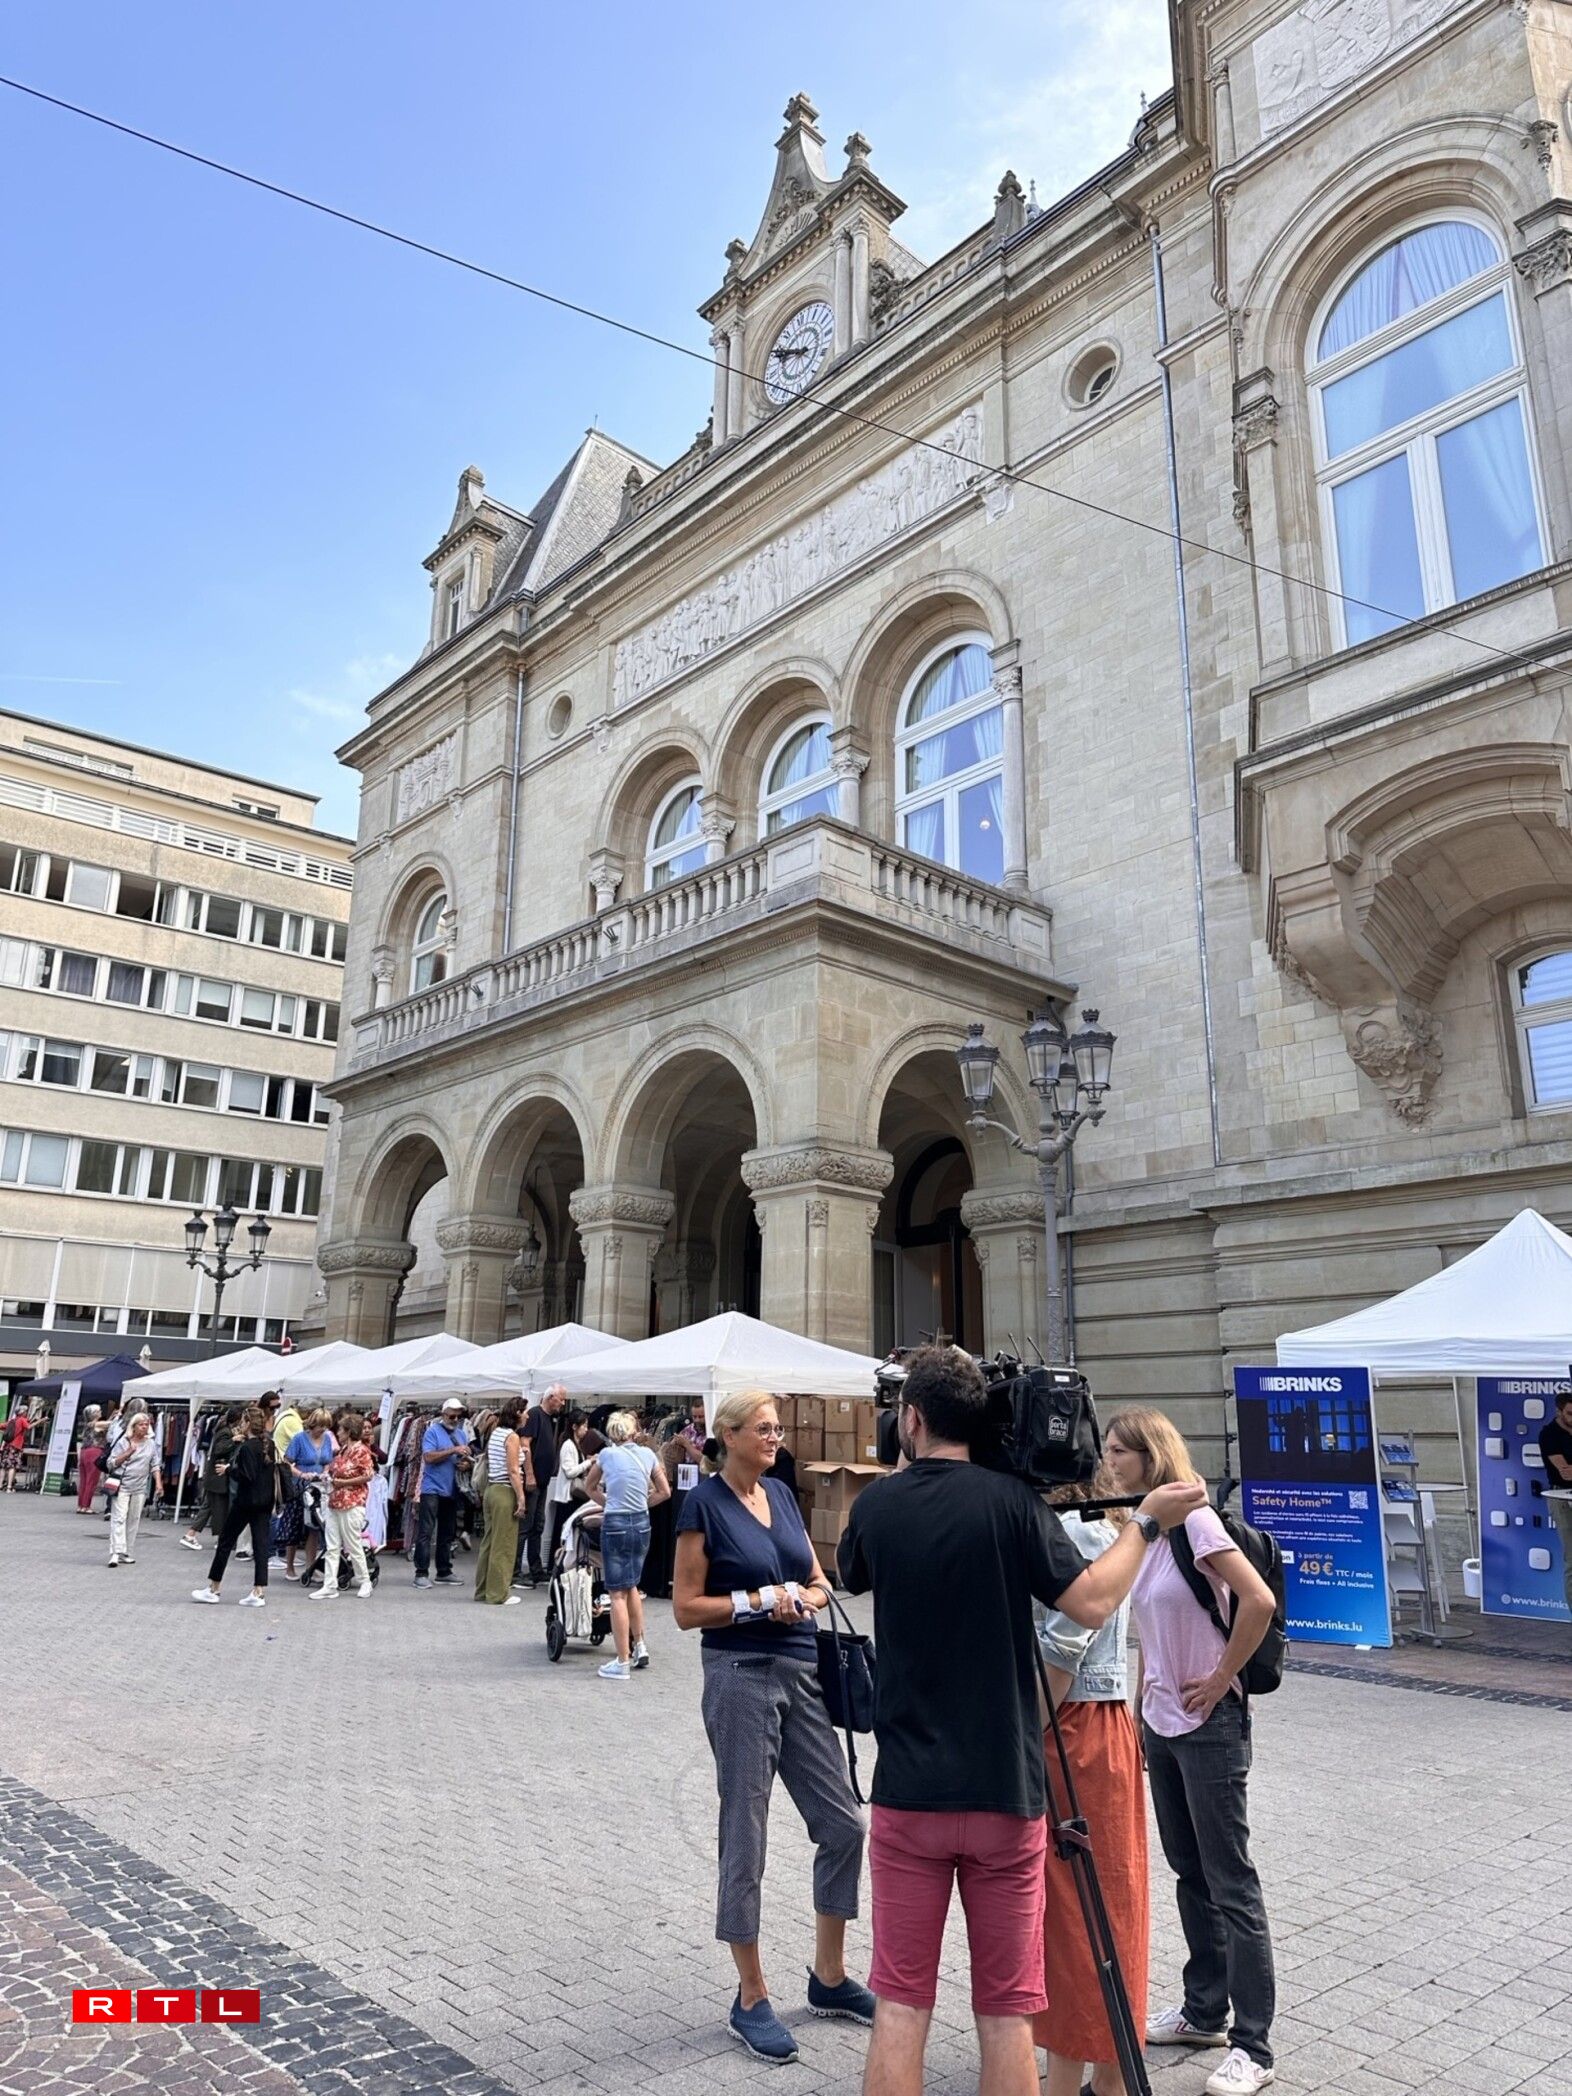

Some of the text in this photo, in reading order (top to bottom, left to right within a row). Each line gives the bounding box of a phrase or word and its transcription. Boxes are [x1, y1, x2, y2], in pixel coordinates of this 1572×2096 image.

[1273, 1377, 1343, 1392] BRINKS
[1252, 1496, 1287, 1508] Safety
[1286, 1619, 1363, 1632] www.brinks.lu
